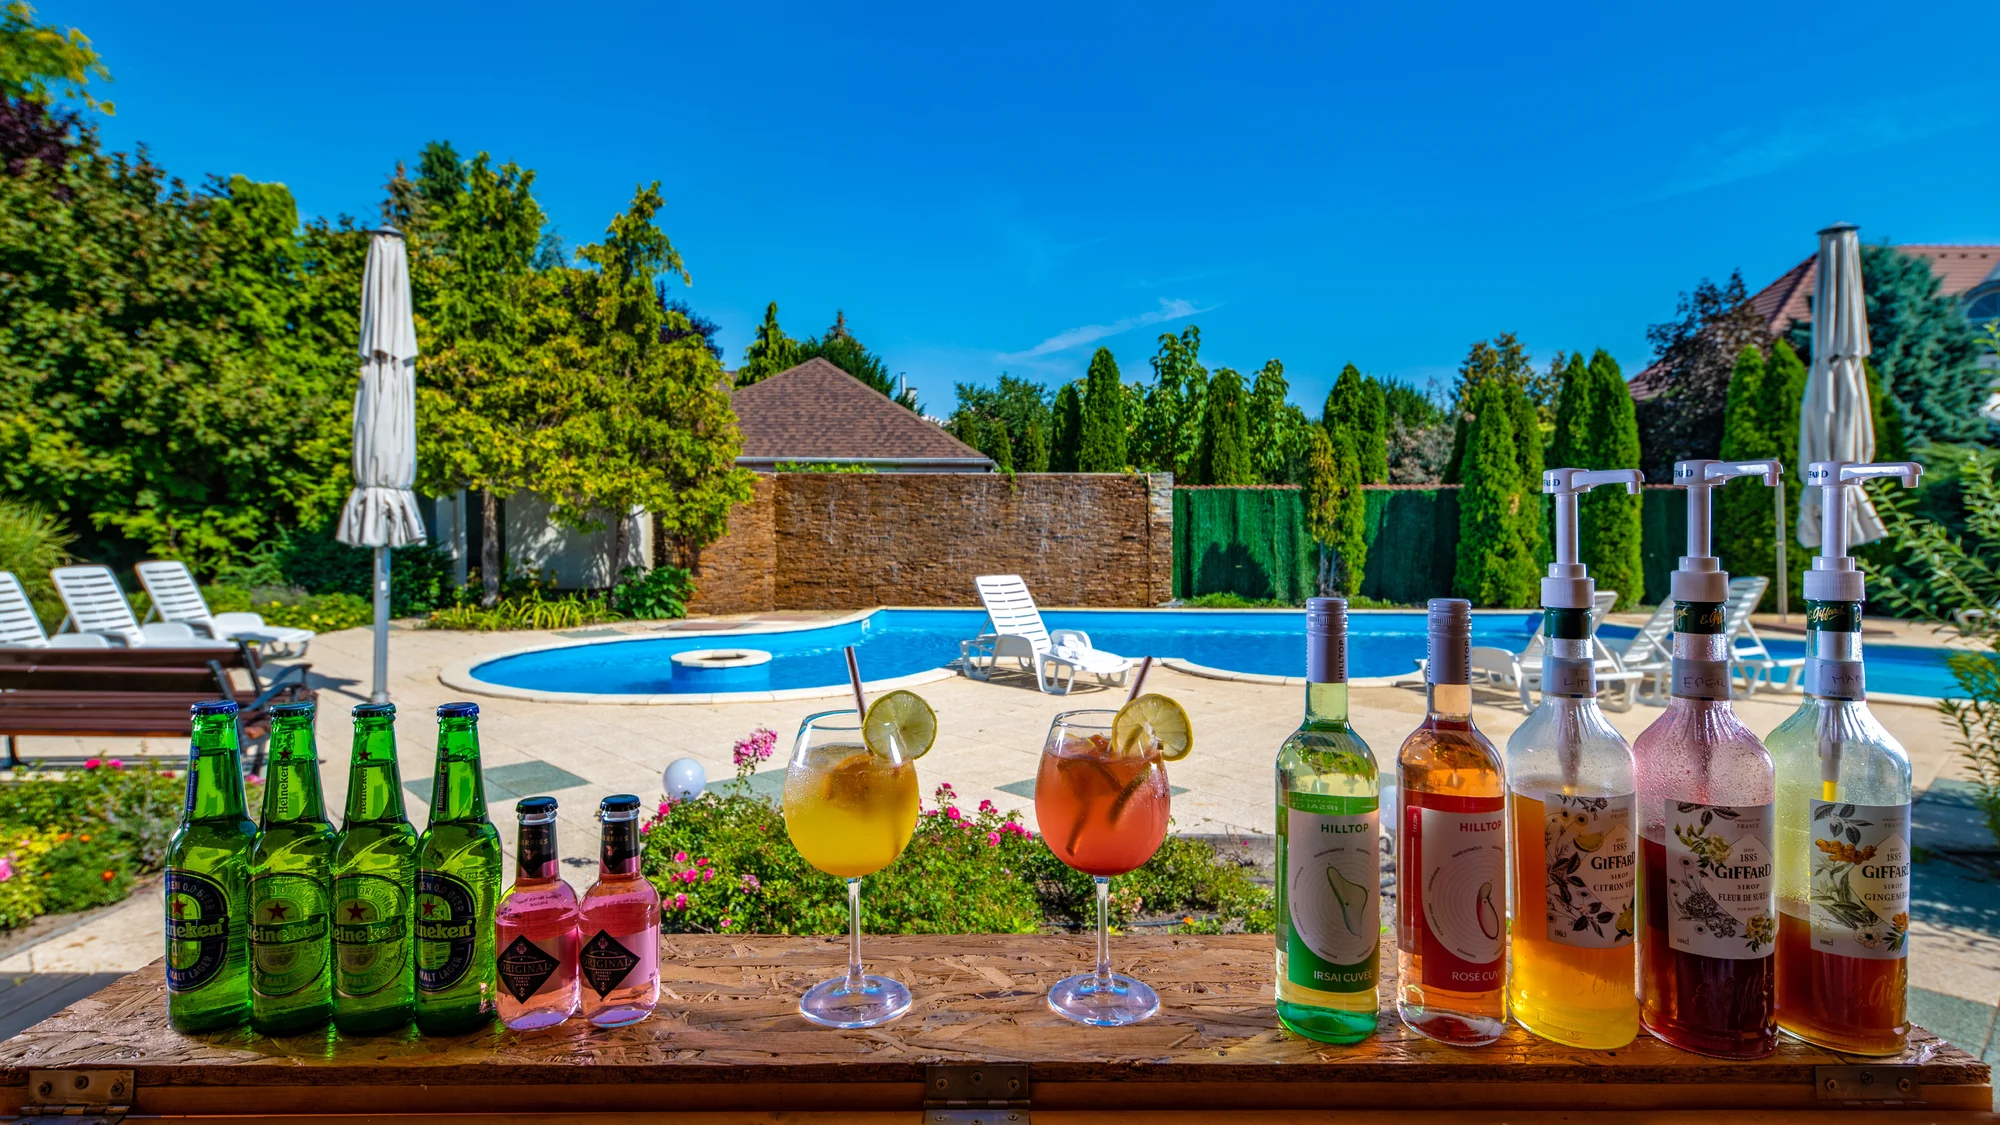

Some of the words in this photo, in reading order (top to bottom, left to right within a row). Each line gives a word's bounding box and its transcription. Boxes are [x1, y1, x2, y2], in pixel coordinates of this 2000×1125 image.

[1683, 676, 1726, 688] EPER
[279, 763, 289, 814] Heineken
[1321, 823, 1368, 833] HILLTOP
[1460, 820, 1502, 832] HILLTOP
[520, 838, 548, 846] ERRIES
[602, 834, 629, 842] ERRIES
[1613, 842, 1627, 853] 1885
[1591, 851, 1635, 870] GIFFARD
[1740, 853, 1758, 863] 1885
[1886, 852, 1902, 862] 1885
[1610, 872, 1629, 880] SIROP
[1714, 863, 1771, 879] GIFFARD
[1593, 883, 1624, 892] CITRON
[1718, 893, 1742, 902] FLEUR
[1743, 894, 1752, 902] DE
[247, 921, 324, 943] Heineken
[188, 956, 214, 979] LAGER
[501, 962, 550, 974] ORIGINAL
[583, 958, 632, 969] ORIGINAL
[419, 970, 436, 982] MALT
[439, 957, 462, 980] LAGER
[1314, 970, 1341, 982] IRSAI
[1343, 969, 1373, 982] CUVÉE
[1452, 970, 1480, 981] ROSÉ
[1482, 970, 1500, 980] CUV
